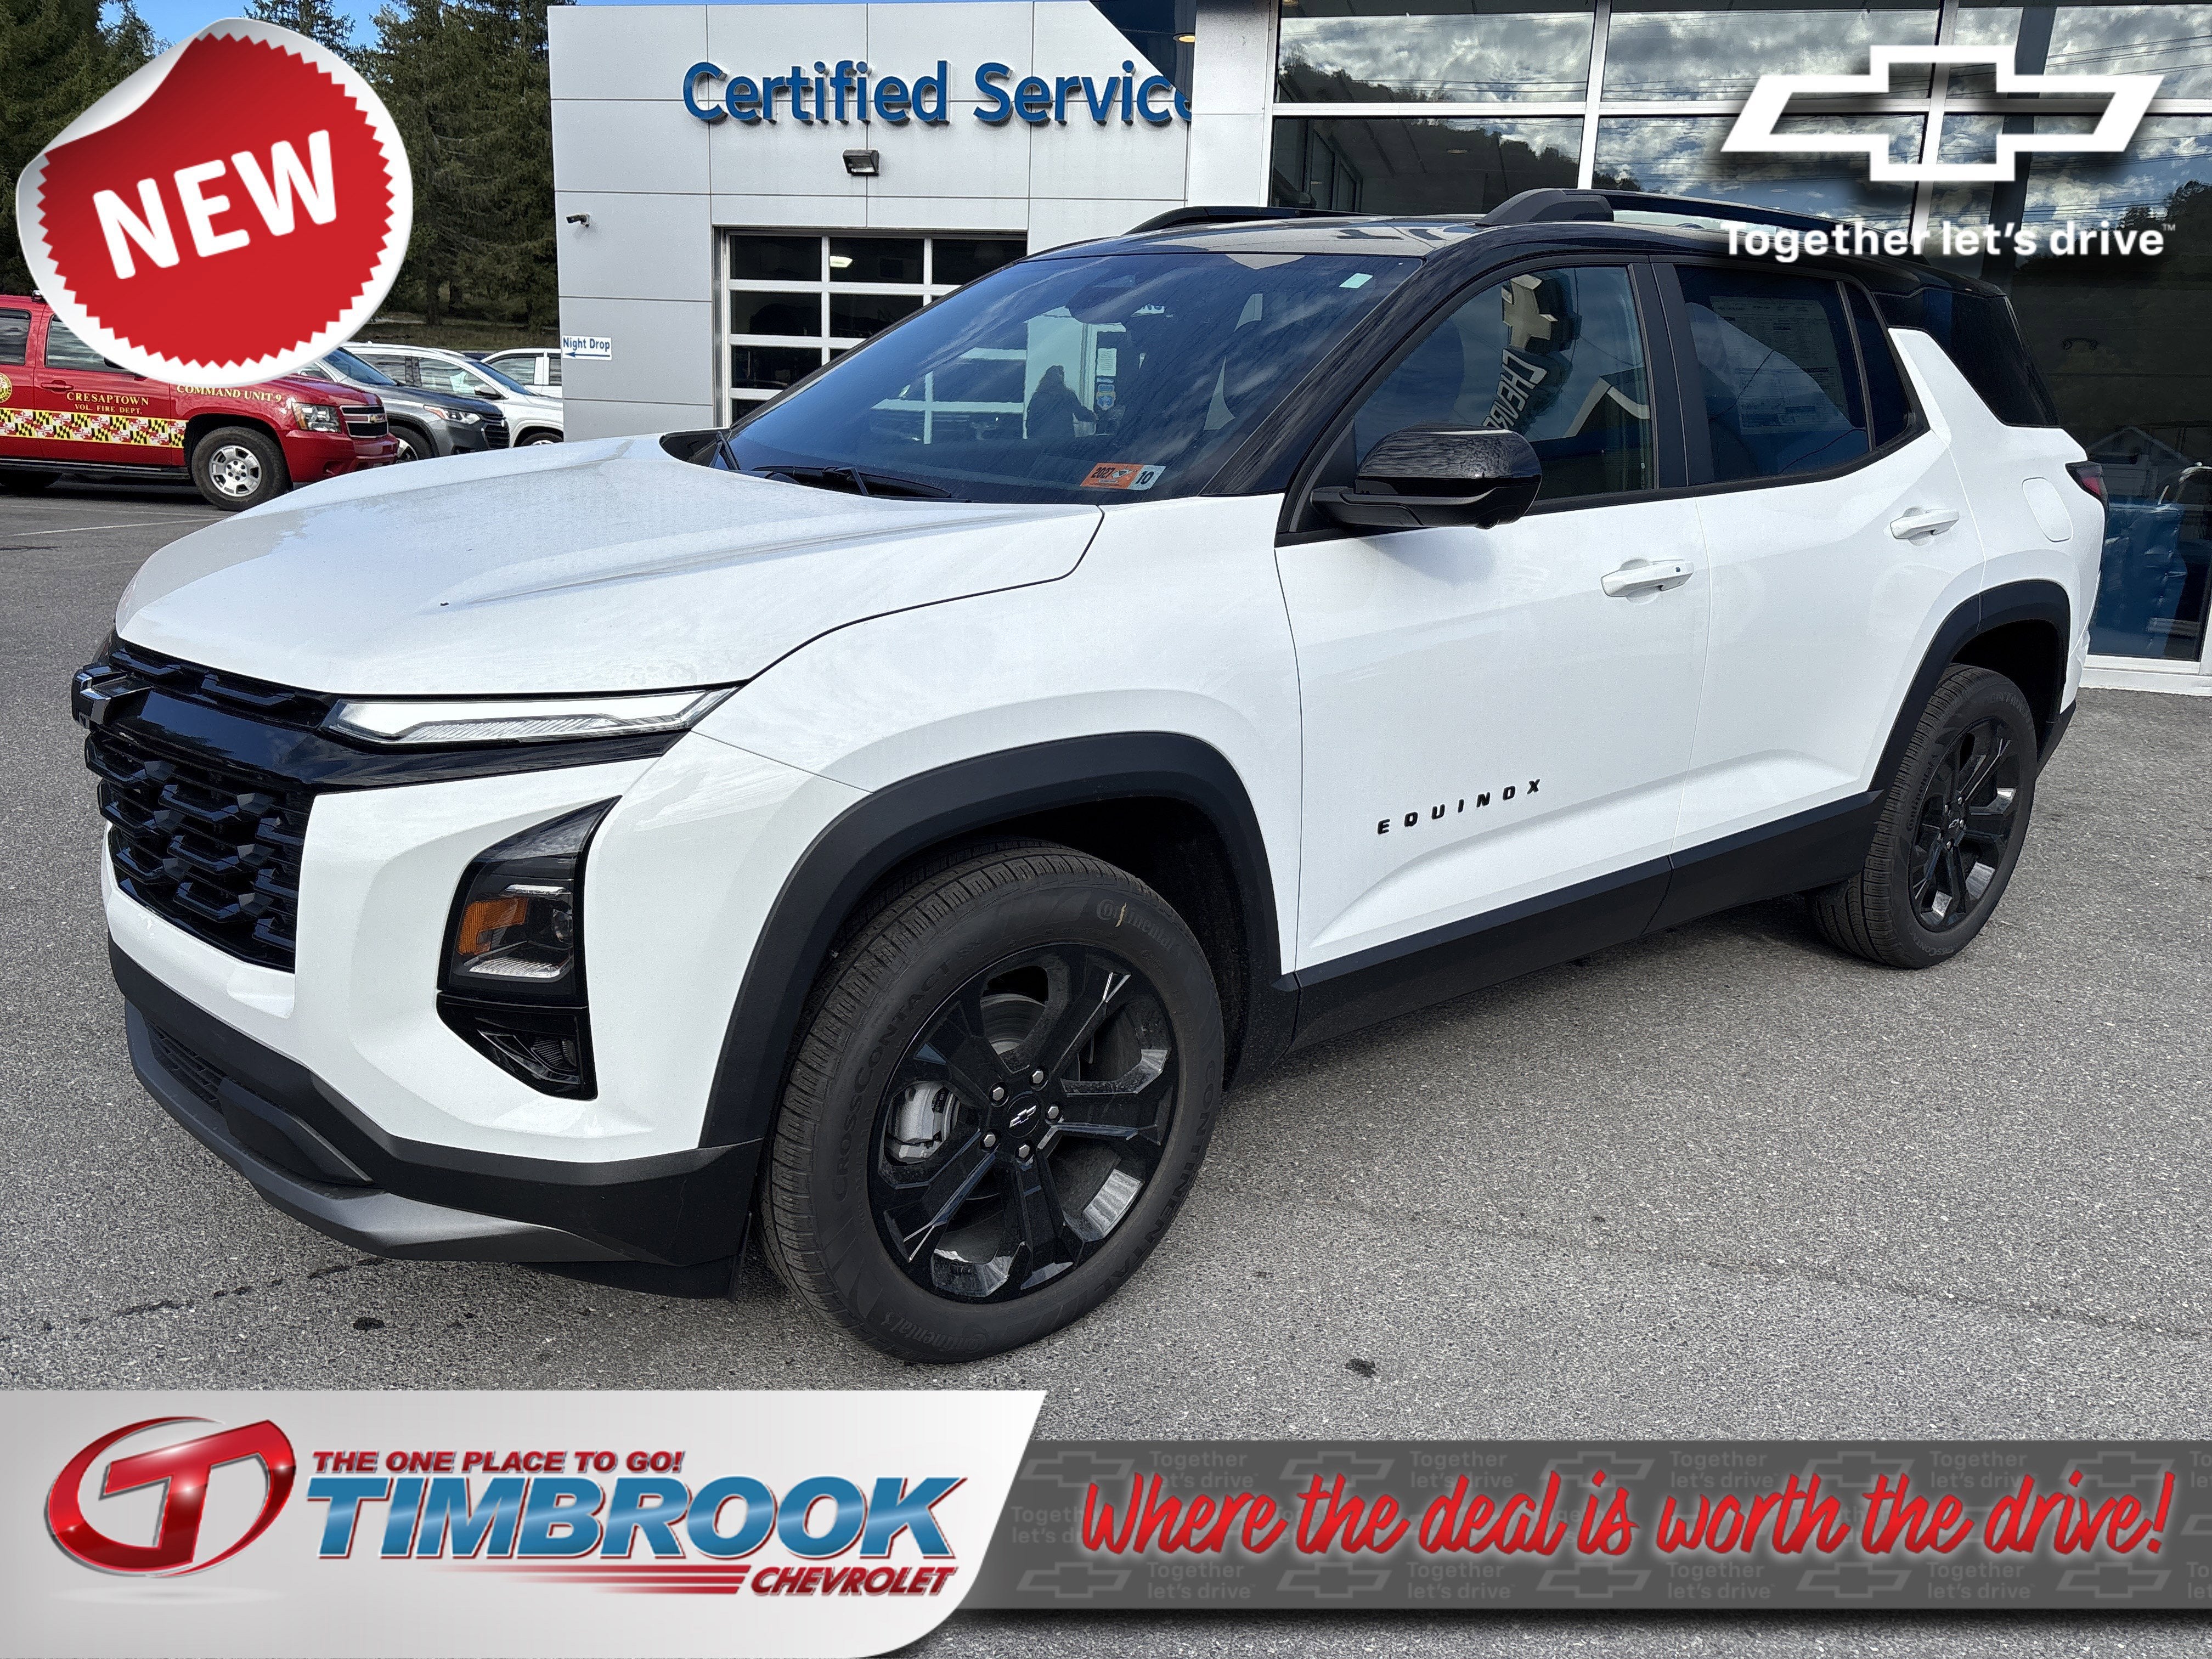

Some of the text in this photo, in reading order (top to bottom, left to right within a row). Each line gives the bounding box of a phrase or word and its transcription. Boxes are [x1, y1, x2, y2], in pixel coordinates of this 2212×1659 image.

[682, 59, 951, 125] Certified
[563, 337, 610, 352] Night Drop
[66, 391, 149, 406] CRESAPTOWN
[177, 385, 282, 403] COMMAND UNIT 9
[75, 403, 93, 411] VOL.
[119, 407, 143, 415] DEPT.
[1090, 467, 1116, 479] 2027
[1135, 470, 1154, 486] 10
[1377, 778, 1541, 835] EQUINOX
[1095, 1059, 1217, 1293] CONTINENTAL
